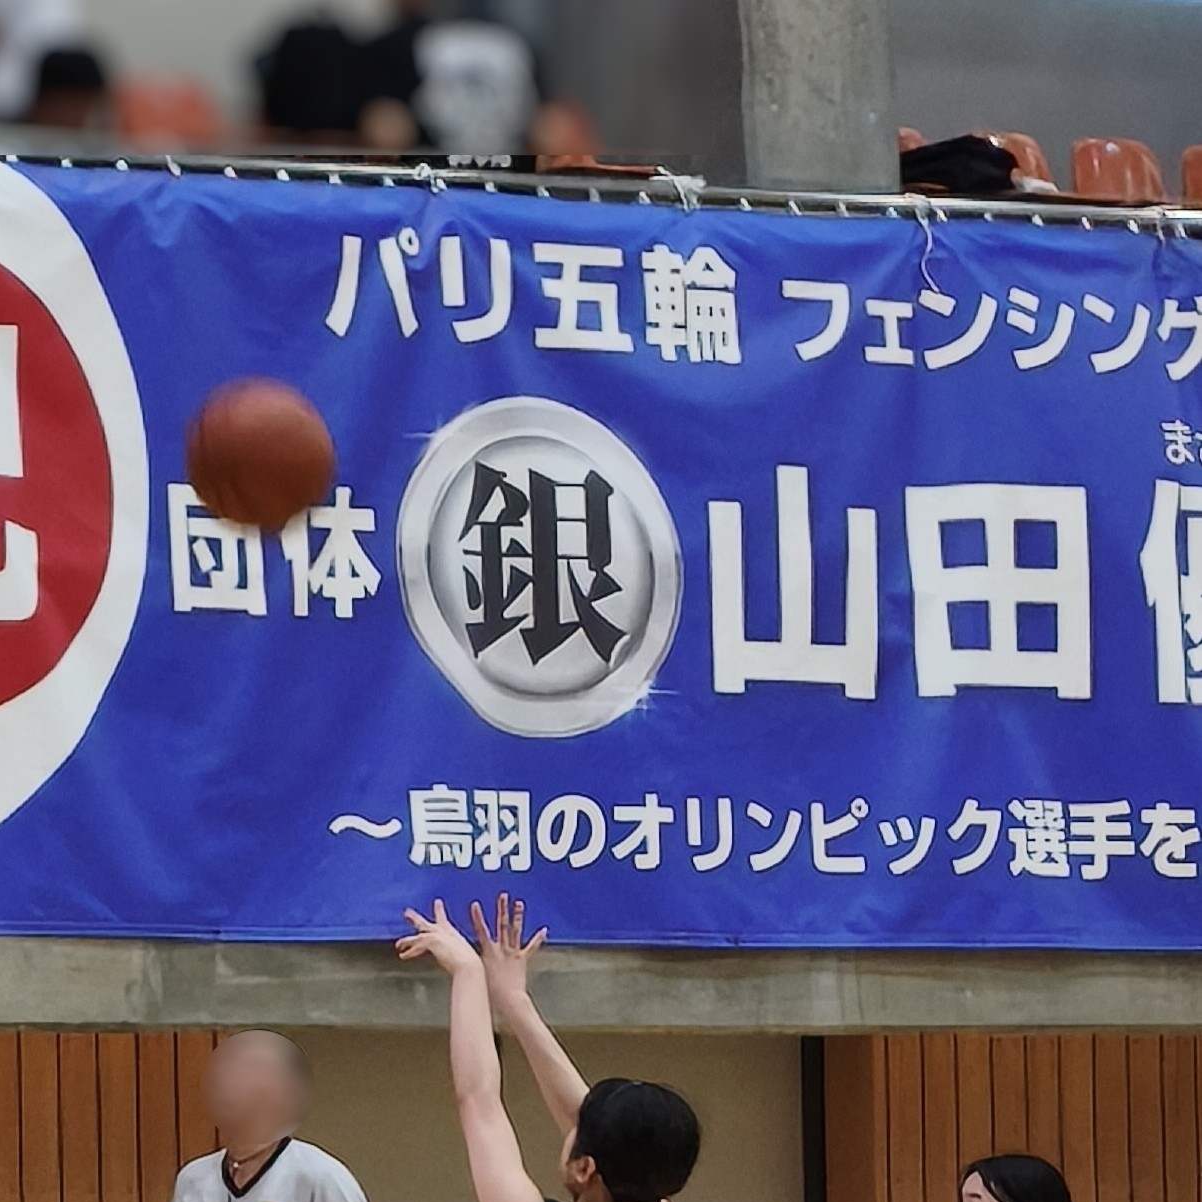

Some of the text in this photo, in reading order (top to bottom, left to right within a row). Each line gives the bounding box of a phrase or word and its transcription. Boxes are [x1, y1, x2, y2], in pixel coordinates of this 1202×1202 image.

[325, 227, 741, 364] パリ五輪
[1161, 419, 1202, 465] ま
[167, 483, 381, 618] 団体
[458, 461, 628, 666] 銀
[708, 465, 1091, 701] 山田
